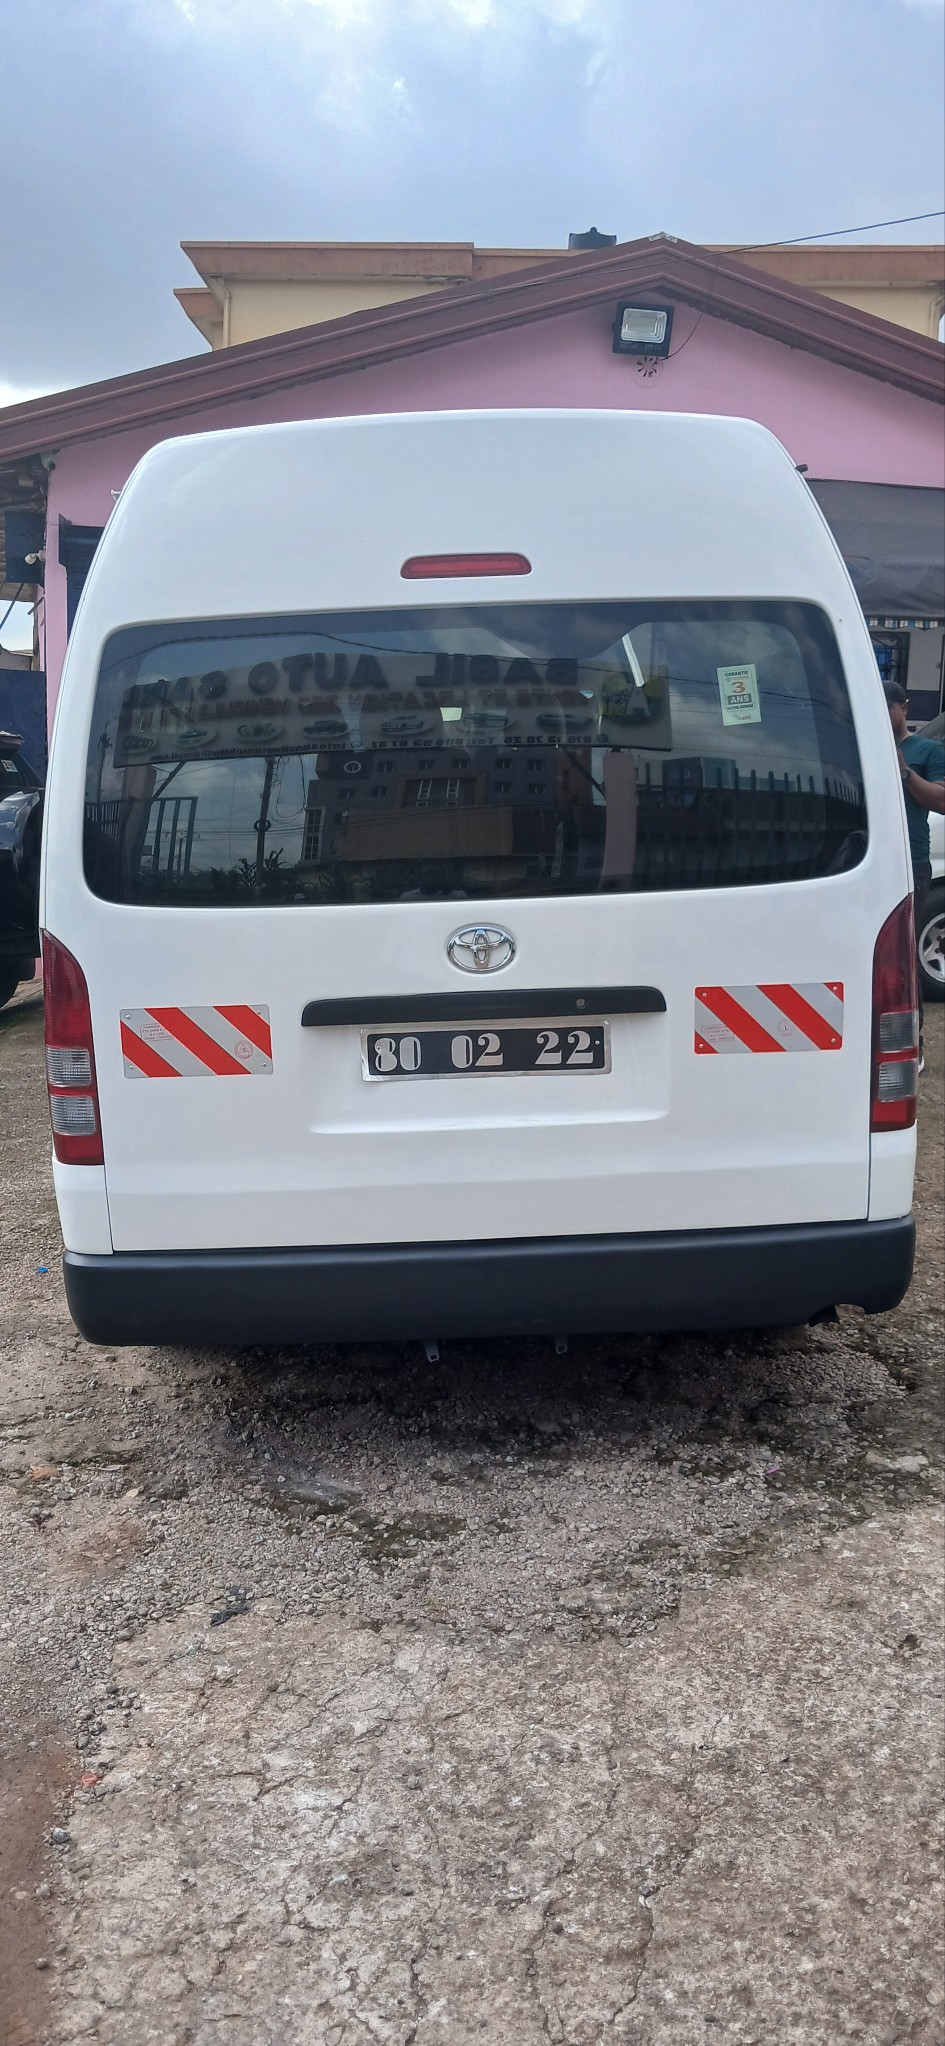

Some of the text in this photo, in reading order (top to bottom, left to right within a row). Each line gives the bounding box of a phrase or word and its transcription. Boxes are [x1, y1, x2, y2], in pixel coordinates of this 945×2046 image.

[731, 681, 746, 694] 3
[730, 694, 749, 704] ANS
[374, 1030, 594, 1072] 80 02 22
